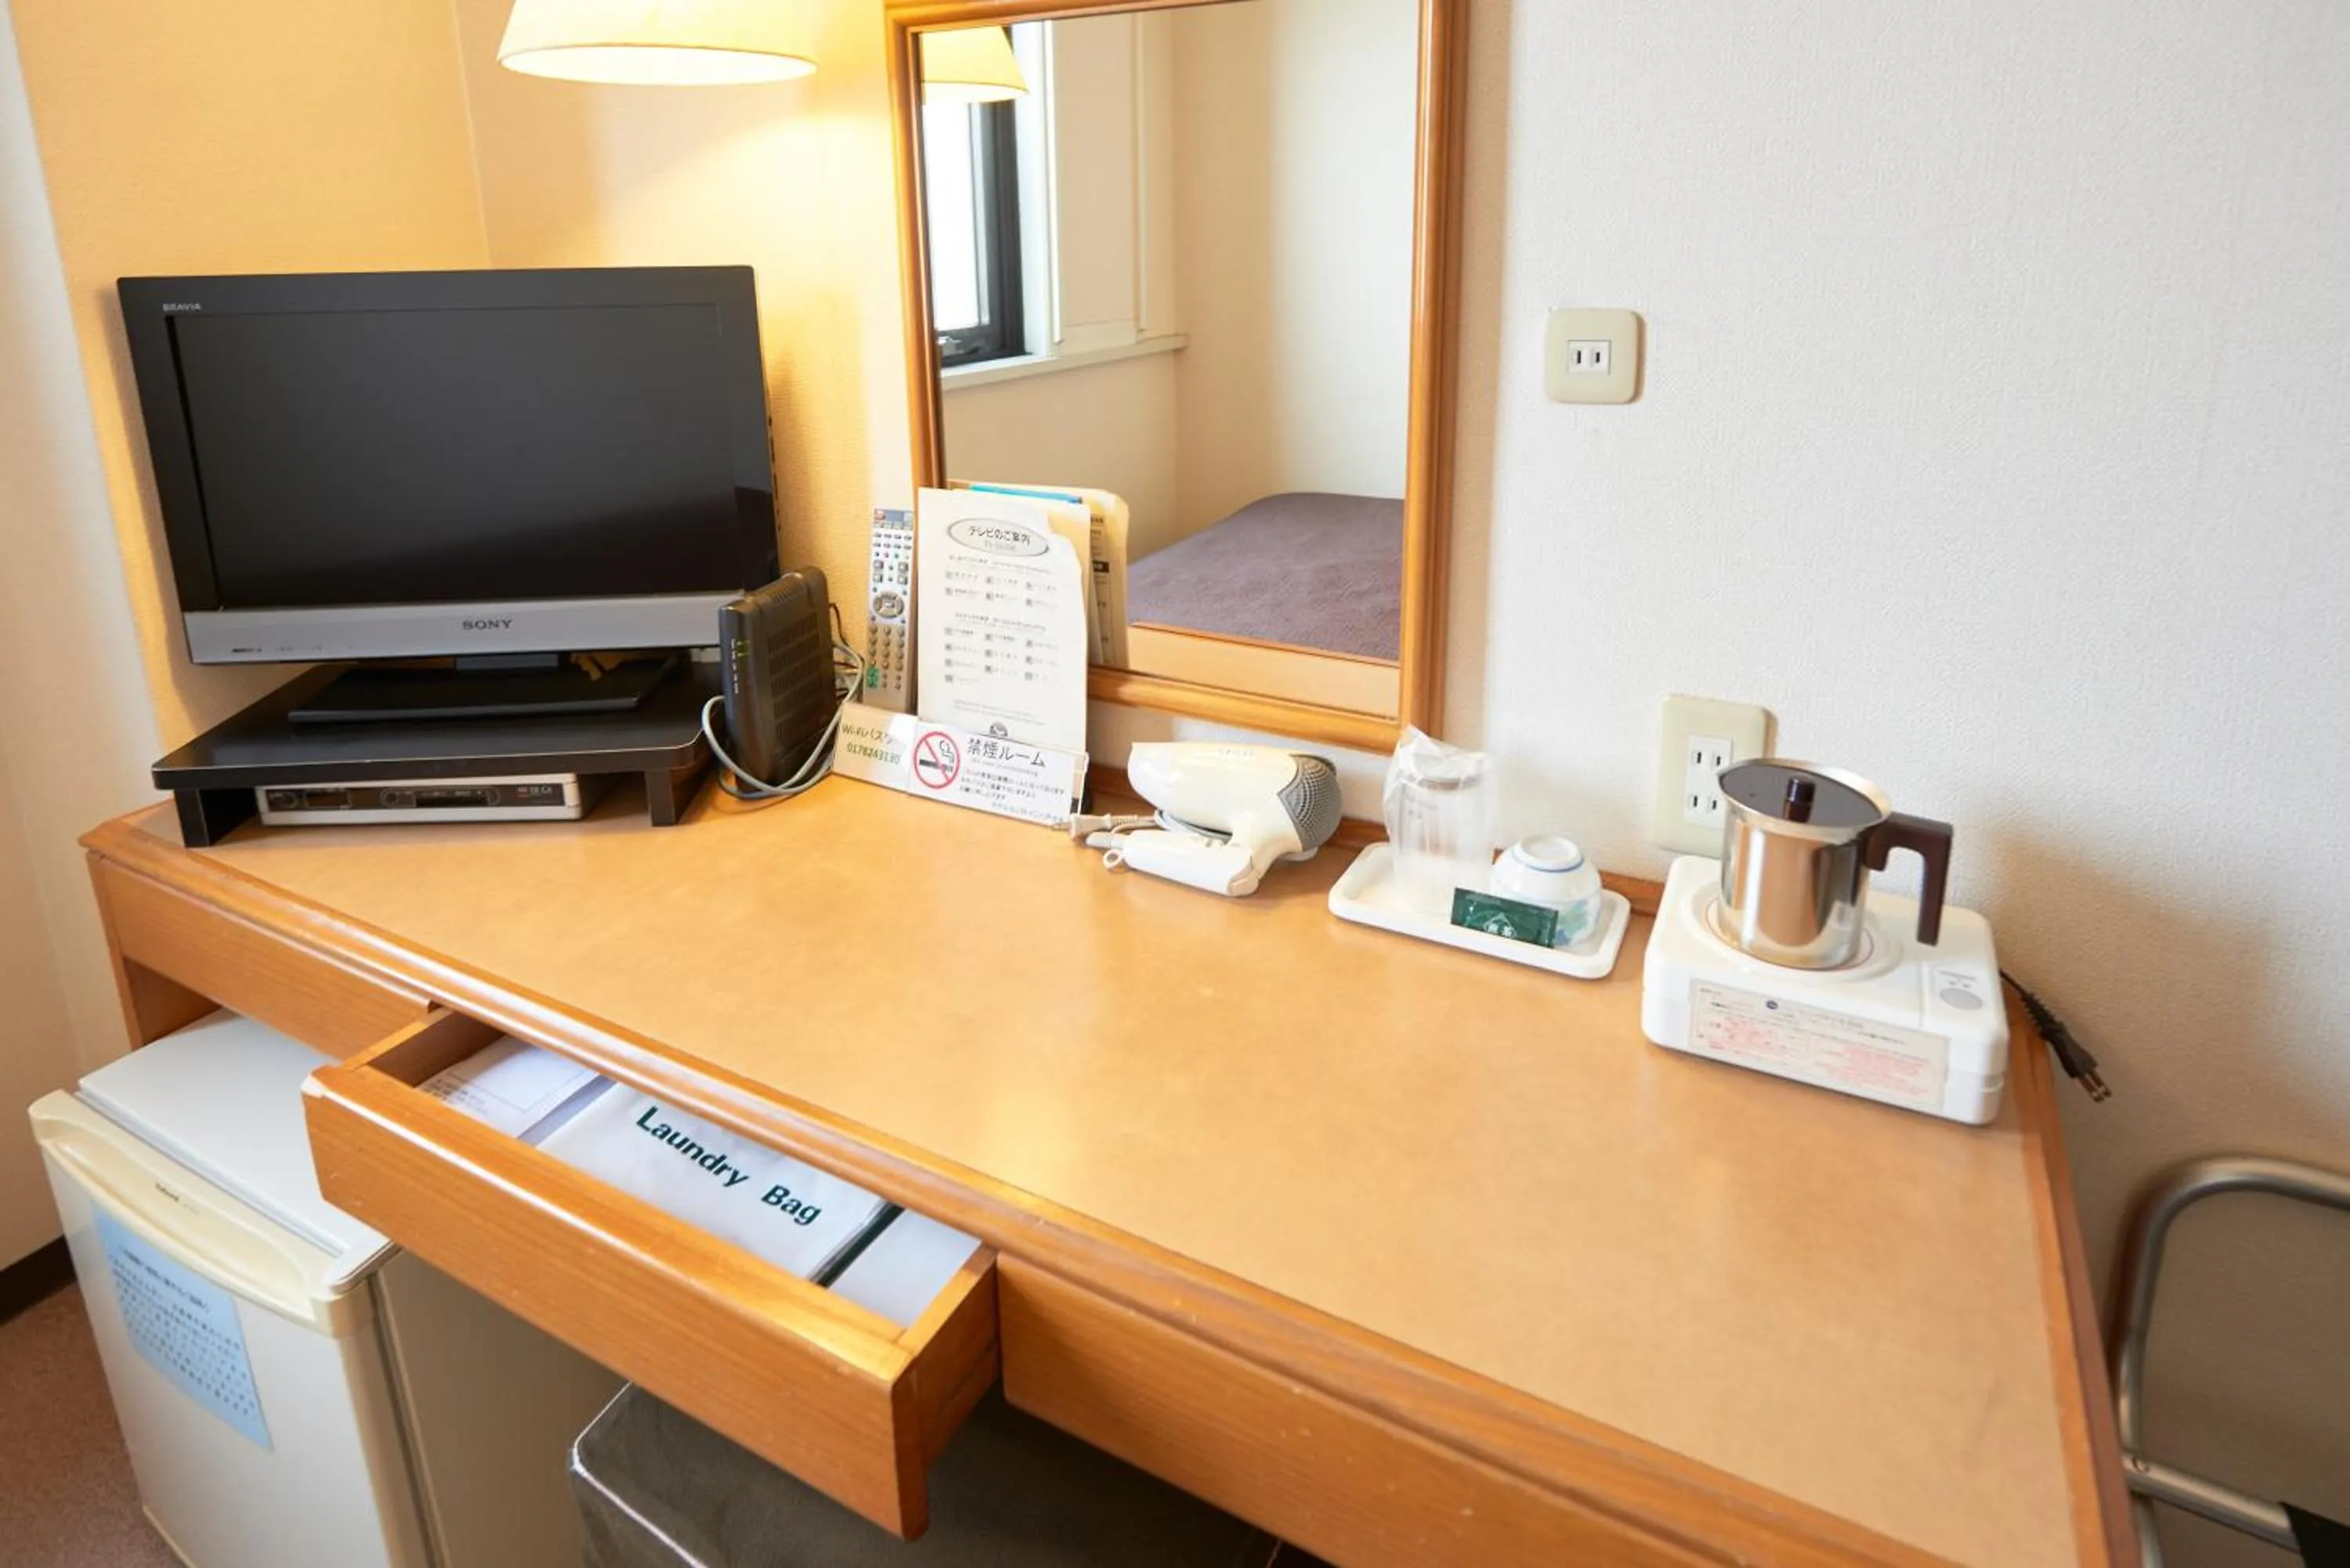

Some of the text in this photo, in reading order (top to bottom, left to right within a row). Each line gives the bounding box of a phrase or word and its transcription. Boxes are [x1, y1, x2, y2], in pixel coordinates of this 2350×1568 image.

[162, 303, 201, 312] BRAVIA
[462, 620, 513, 630] SONY
[967, 738, 1046, 768] 禁煙ルーム
[635, 1106, 822, 1226] Laundry Bag
